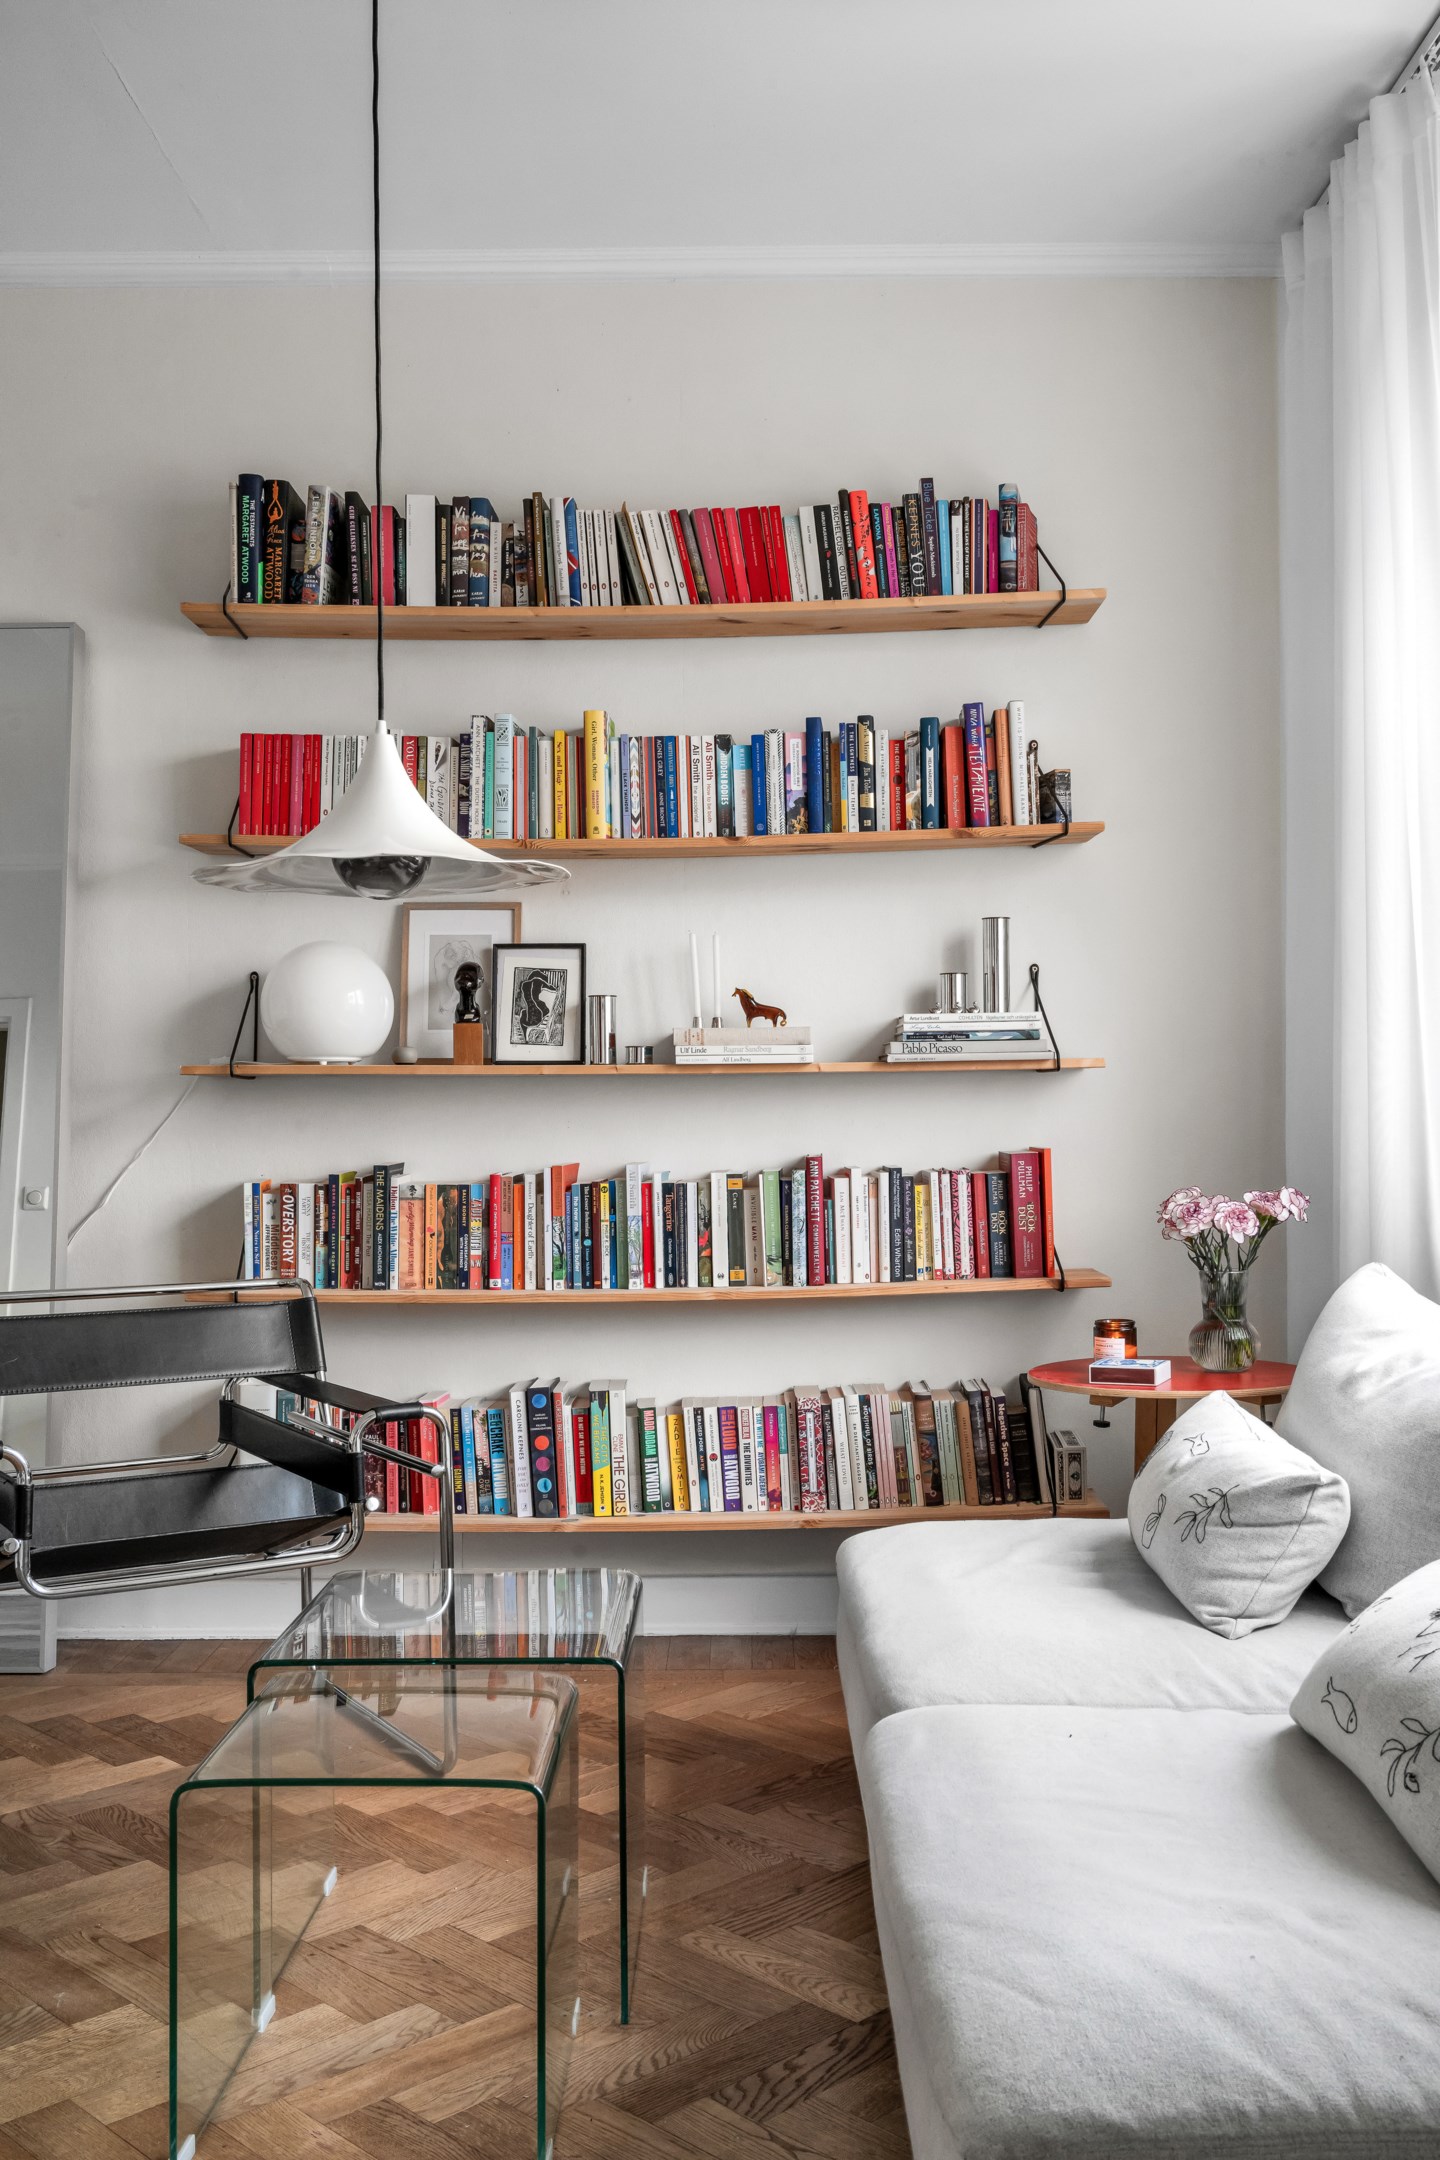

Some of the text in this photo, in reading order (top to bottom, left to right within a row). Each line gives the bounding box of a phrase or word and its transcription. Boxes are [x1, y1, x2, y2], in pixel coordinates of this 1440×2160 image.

[923, 483, 932, 503] Blue
[455, 506, 466, 518] Vi
[925, 506, 934, 532] Ticket
[309, 521, 317, 561] EINHORN
[455, 524, 467, 535] for
[832, 506, 848, 598] RACHEL CUSK OUTLINE
[908, 499, 925, 587] KEPNES YOU
[265, 547, 273, 599] ATWOOD
[274, 547, 282, 599] MARGARET
[406, 740, 414, 761] YOU
[705, 755, 713, 780] Smith
[970, 747, 985, 813] TESTAMENTE
[720, 780, 728, 805] BODIES
[902, 1043, 963, 1054] Pablo Picasso
[376, 1170, 384, 1186] THE
[809, 1160, 818, 1177] ANN
[376, 1189, 384, 1231] MAIDENS
[629, 1185, 637, 1209] Smith
[810, 1180, 820, 1221] PATCHETT
[390, 1211, 398, 1224] The
[406, 1202, 414, 1220] Early
[998, 1211, 1006, 1235] BOOK
[1018, 1207, 1026, 1232] DUST
[1027, 1204, 1035, 1233] BOOK
[283, 1195, 294, 1263] OVERSTORY
[390, 1225, 398, 1247] White
[407, 1221, 416, 1247] Warning
[528, 1231, 534, 1239] of
[271, 1224, 279, 1271] Middlesex
[390, 1249, 398, 1272] Album
[593, 1415, 599, 1427] WE
[742, 1427, 750, 1439] BILAL
[862, 1406, 870, 1436] MOUTHFUL
[866, 1439, 871, 1447] OF
[491, 1427, 504, 1454] CRAKE
[743, 1442, 751, 1453] THE
[998, 1404, 1010, 1467] Negative Space
[644, 1410, 660, 1502] MADDADDAM ATWOOD
[722, 1421, 740, 1499] FLOOD ATWOOD
[493, 1464, 507, 1499] ATWOOD
[744, 1455, 752, 1486] DIVINITIES
[614, 1455, 626, 1513] THE GIRLS
